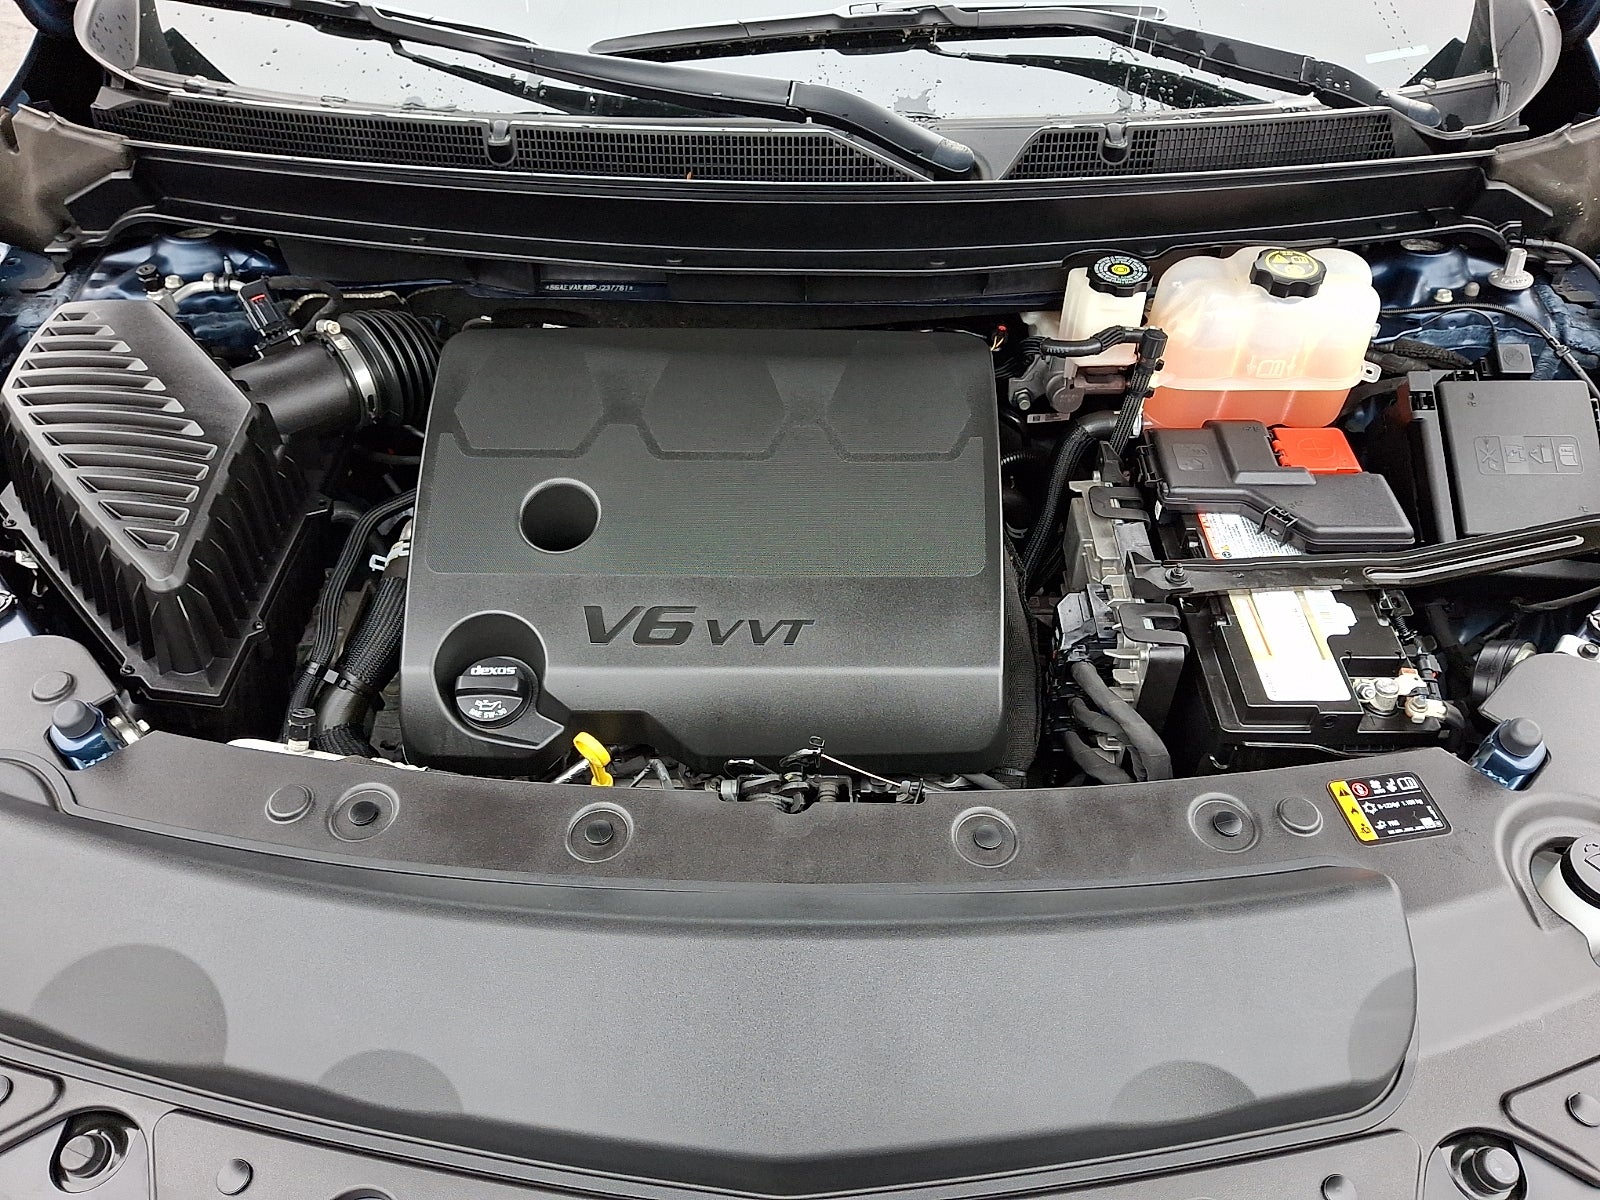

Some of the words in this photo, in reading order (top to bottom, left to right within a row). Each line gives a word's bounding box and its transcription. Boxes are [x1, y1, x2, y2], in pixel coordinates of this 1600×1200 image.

[584, 605, 697, 646] V6
[707, 619, 815, 646] VVT
[470, 665, 517, 675] dexos
